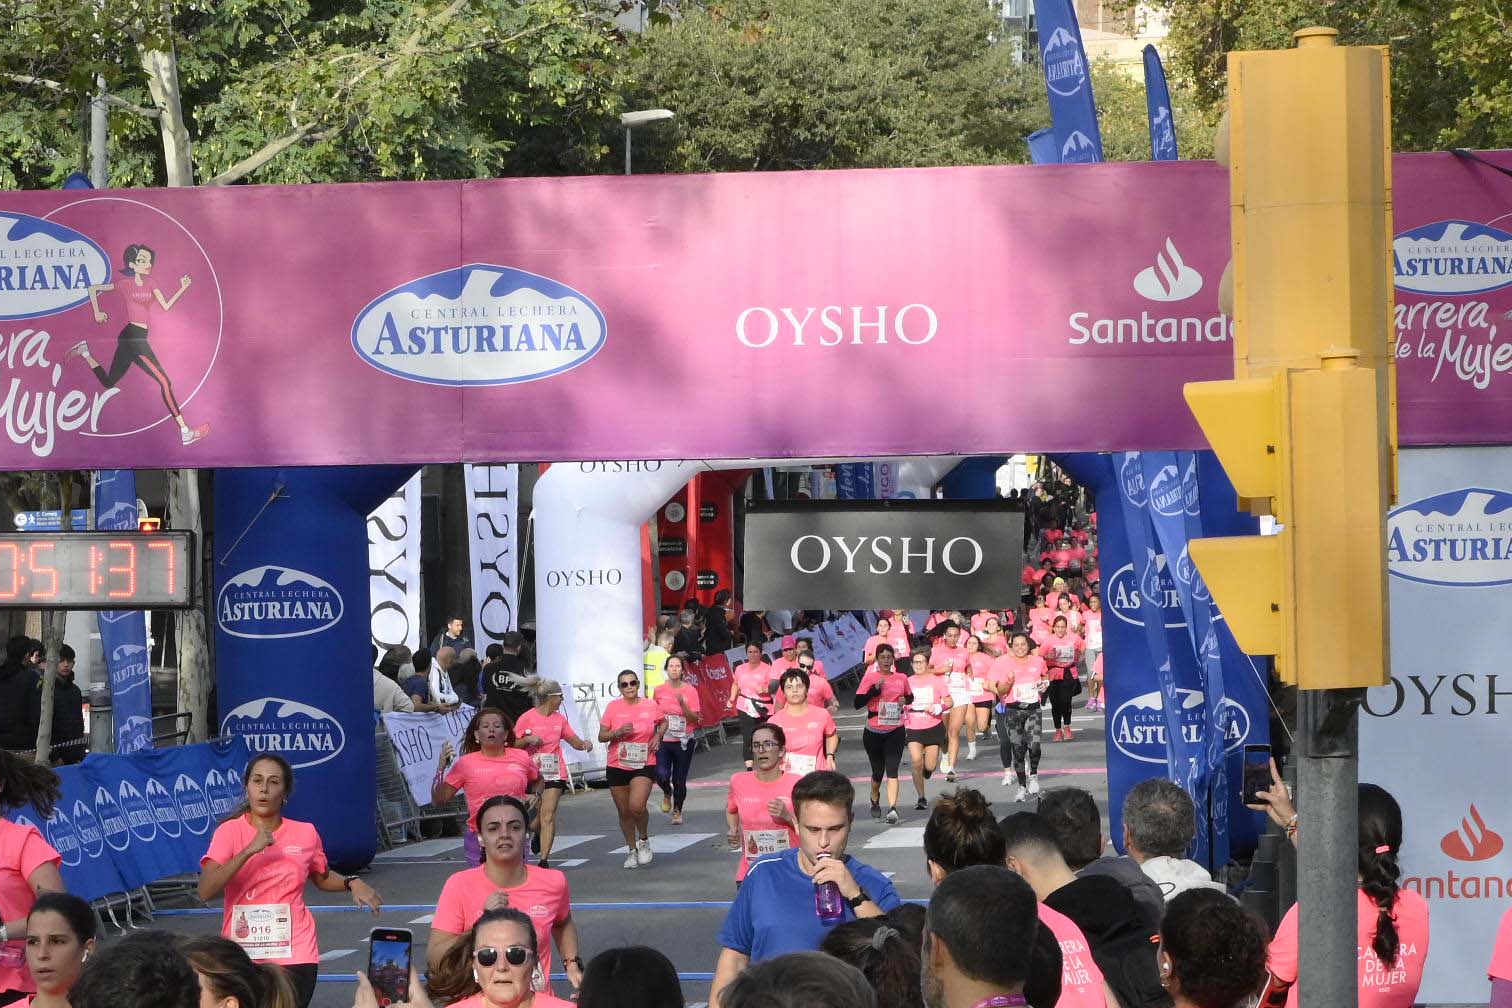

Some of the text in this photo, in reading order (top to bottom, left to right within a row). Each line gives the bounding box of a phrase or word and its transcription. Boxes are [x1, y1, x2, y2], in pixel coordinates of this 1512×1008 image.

[14, 247, 87, 259] LECHERA
[1408, 244, 1512, 255] CENTRAL LECHER
[410, 303, 578, 320] CENTRAL LECHERA
[1394, 301, 1489, 330] arrera
[371, 311, 587, 356] ASTURIANA
[734, 303, 939, 348] OYSHO
[1068, 311, 1235, 345] Santand
[1417, 331, 1435, 359] la
[1432, 325, 1512, 390] Muje
[1416, 522, 1482, 533] CENTRAL
[790, 534, 983, 576] OYSHO
[1387, 526, 1512, 563] ASTURIA
[546, 568, 622, 588] OYSHO
[233, 590, 330, 599] CENTRAL LECHERA
[222, 599, 334, 622] ASTURIANA
[1360, 673, 1512, 718] OYSH
[236, 722, 330, 731] CENTRAL LECHERA
[227, 726, 335, 752] TURIANA
[251, 925, 271, 934] 016
[1362, 971, 1407, 987] MUJER
